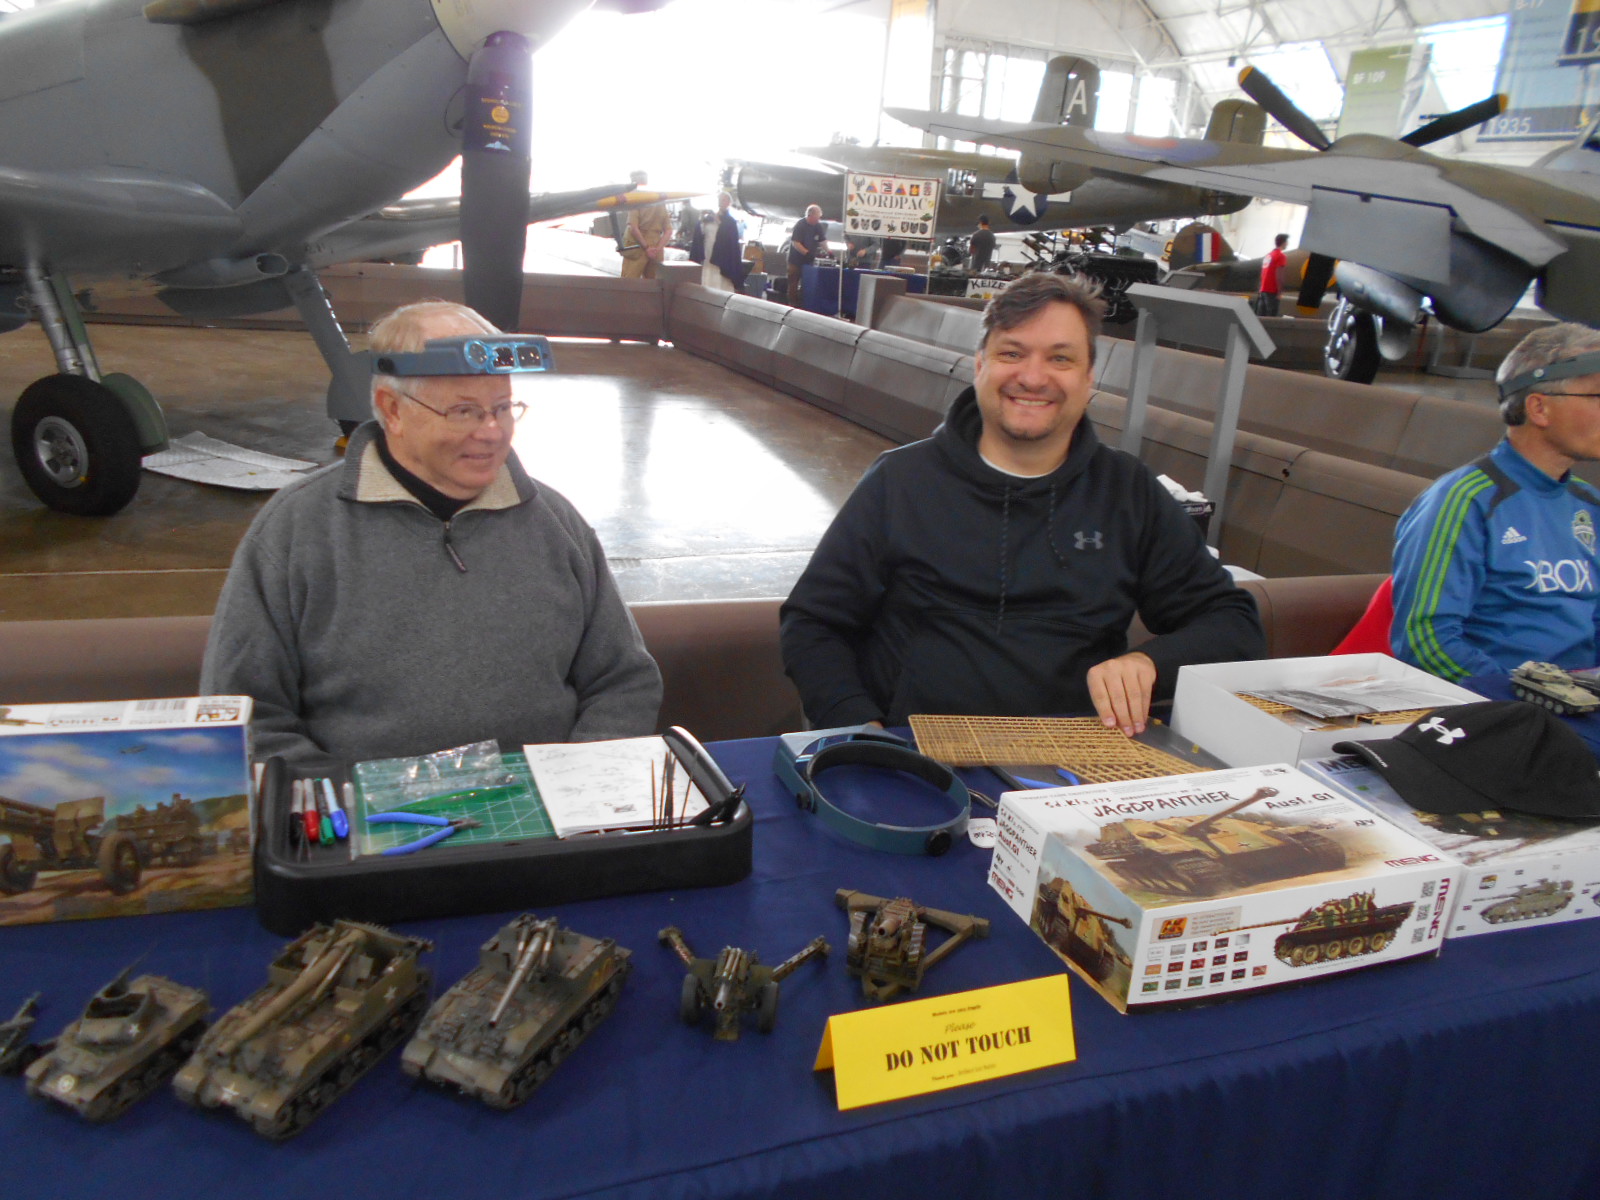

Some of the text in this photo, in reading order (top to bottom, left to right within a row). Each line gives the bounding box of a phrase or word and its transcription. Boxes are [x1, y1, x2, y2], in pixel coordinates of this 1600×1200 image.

[1367, 70, 1386, 83] 109
[1066, 79, 1087, 115] A
[1487, 116, 1532, 136] 1935
[854, 193, 927, 210] NORDPAC
[971, 280, 1007, 290] KEIZE
[1094, 790, 1240, 818] JAGDPANTHER
[1384, 854, 1441, 868] MENG
[1427, 877, 1451, 939] MENG
[944, 1021, 976, 1034] Please
[885, 1025, 1032, 1071] DO NOT TOUCH
